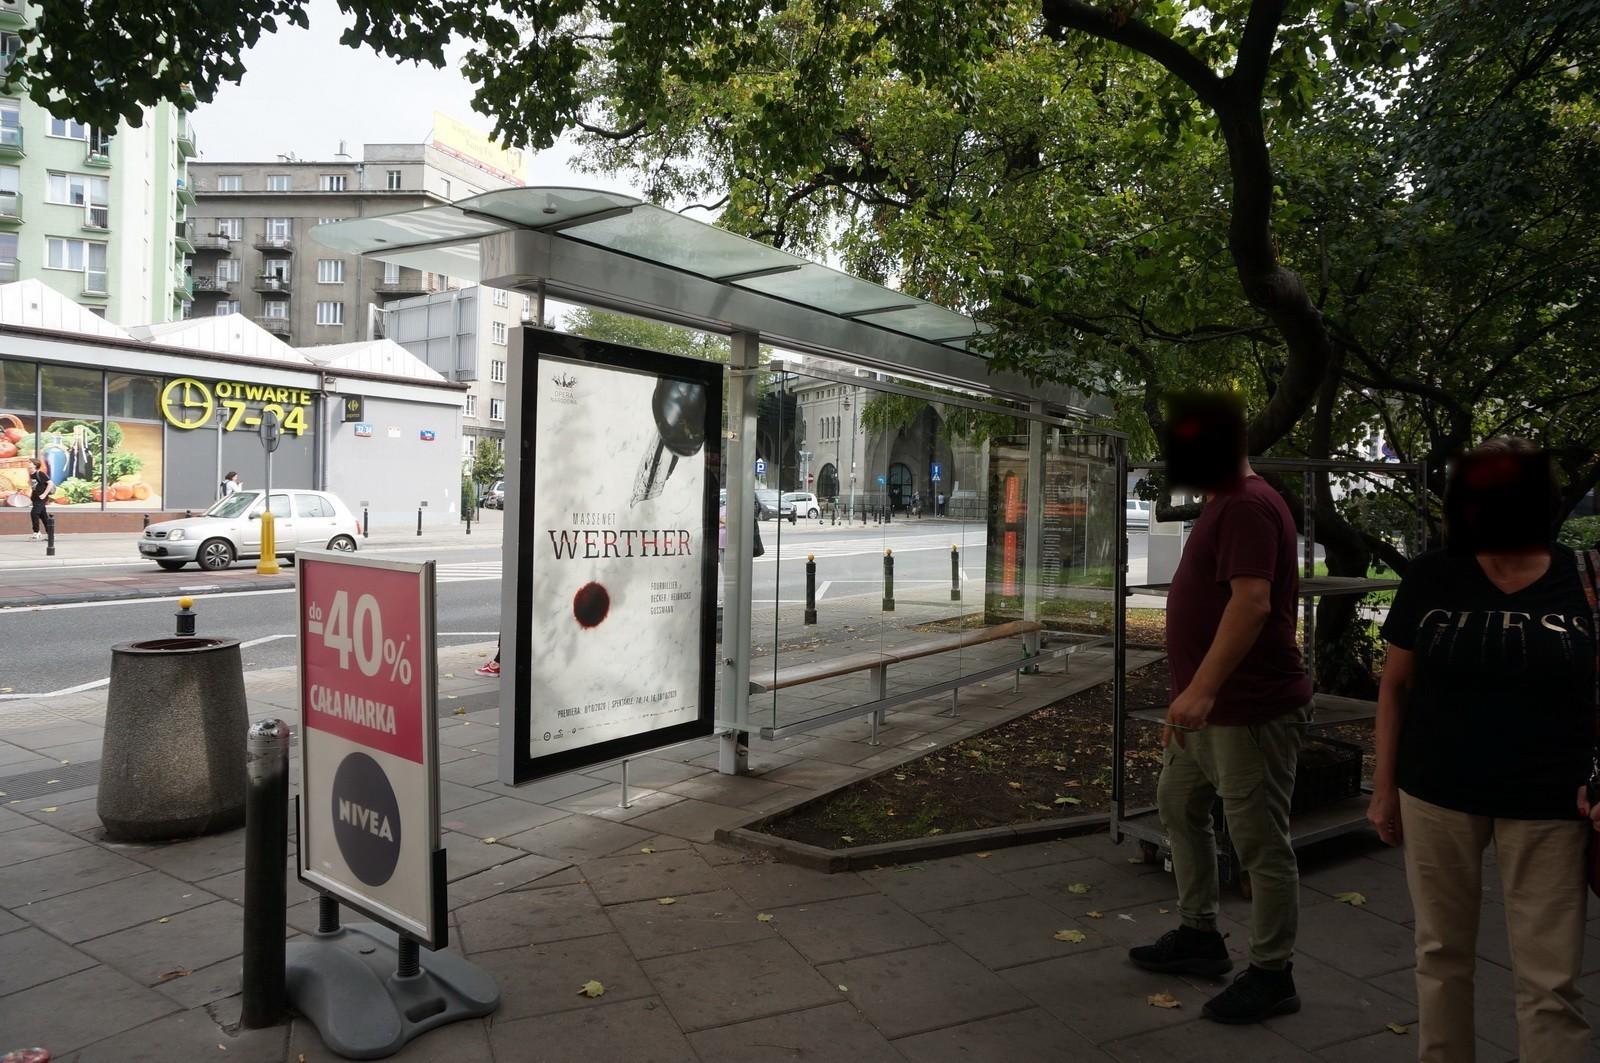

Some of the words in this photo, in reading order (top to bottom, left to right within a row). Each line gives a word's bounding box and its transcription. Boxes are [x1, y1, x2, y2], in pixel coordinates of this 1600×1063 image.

[216, 381, 311, 405] OTWARTE
[572, 512, 616, 526] MASSENET
[548, 530, 691, 560] WERTHER
[309, 602, 322, 620] do
[310, 684, 343, 719] CAŁA
[344, 694, 397, 735] MARKA
[339, 797, 393, 842] NIVEA
